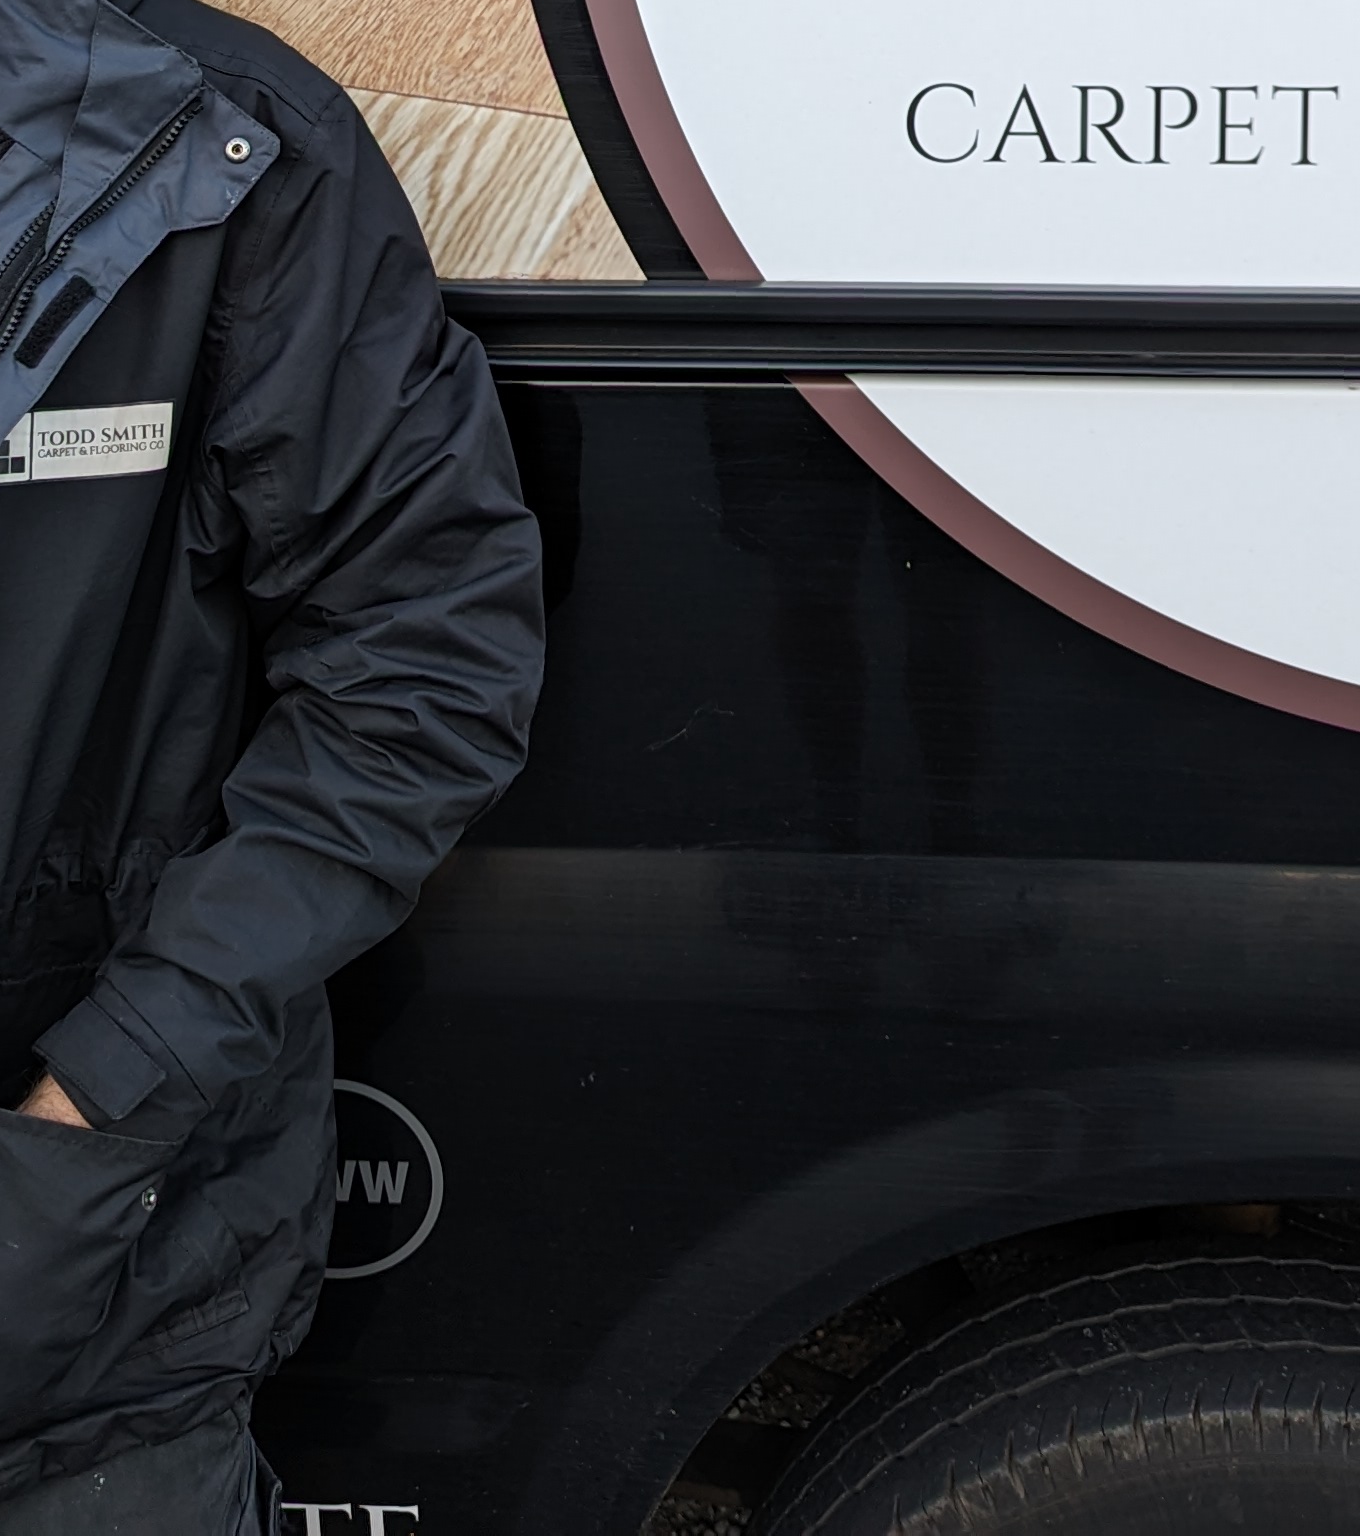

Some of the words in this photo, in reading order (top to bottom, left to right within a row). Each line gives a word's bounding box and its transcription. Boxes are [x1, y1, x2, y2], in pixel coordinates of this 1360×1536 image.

[905, 82, 1341, 169] CARPET
[38, 429, 95, 446] TODD
[101, 423, 164, 442] SMITH
[37, 447, 77, 458] CARPET
[78, 446, 88, 456] &
[89, 442, 147, 455] FLOORING
